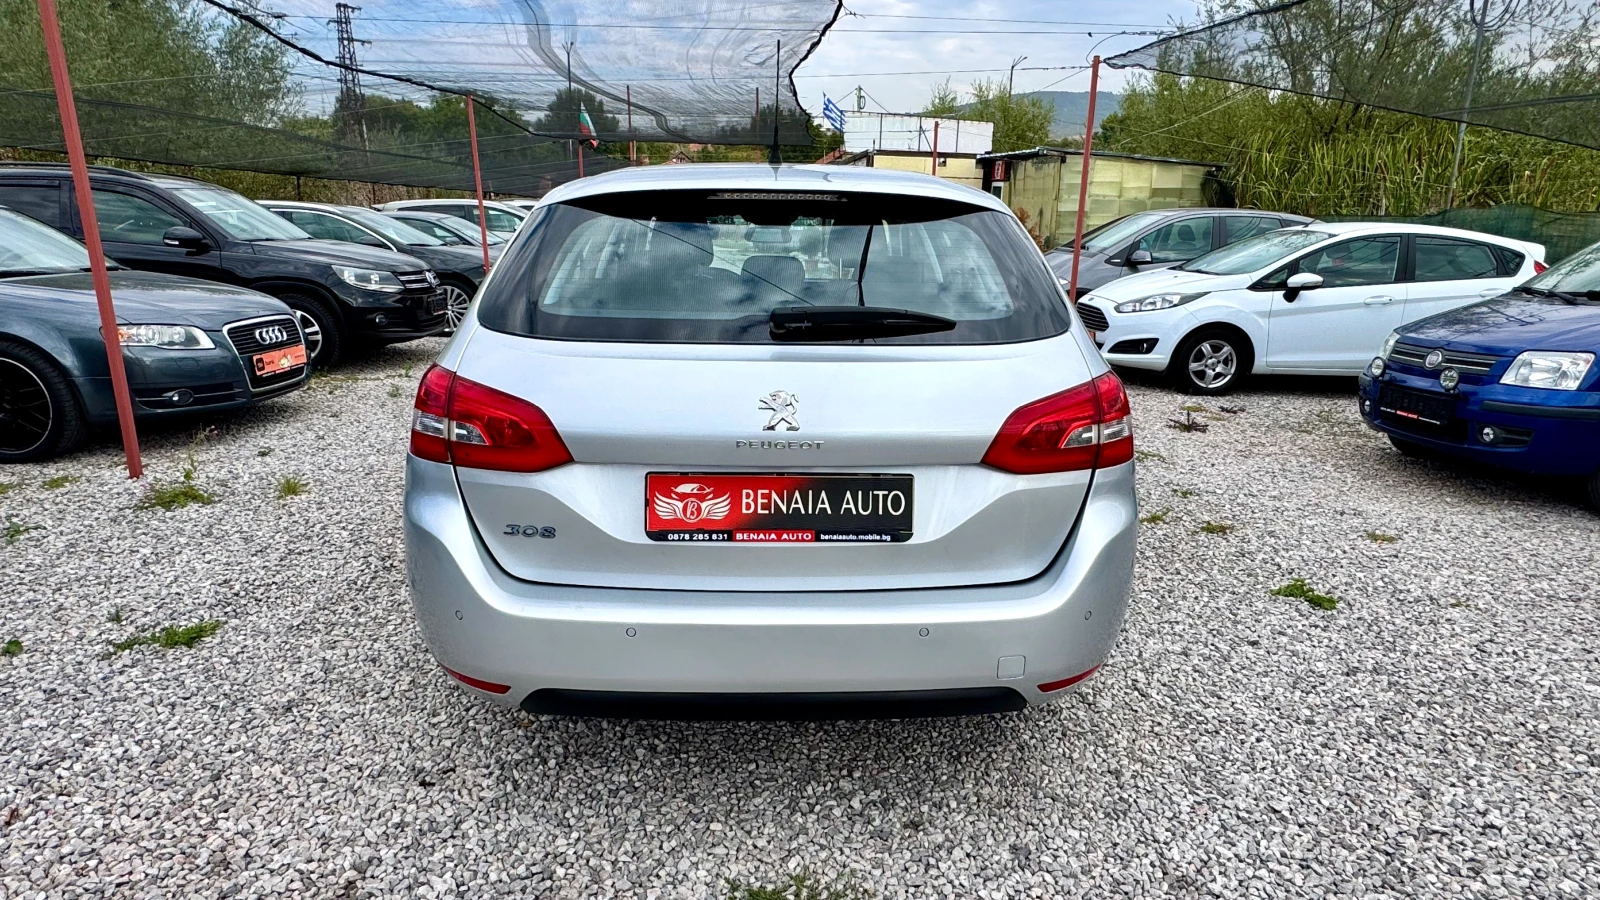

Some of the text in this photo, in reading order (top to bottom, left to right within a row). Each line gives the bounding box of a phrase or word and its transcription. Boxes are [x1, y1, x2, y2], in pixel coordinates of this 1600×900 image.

[736, 439, 825, 450] PEUGEOT
[741, 489, 906, 516] BENAIA AUTO
[503, 523, 557, 539] 308
[667, 533, 728, 541] 0878 285 831
[735, 532, 812, 541] BENAIA AUTO
[820, 533, 891, 542] benaiaauto.mobile.bg
